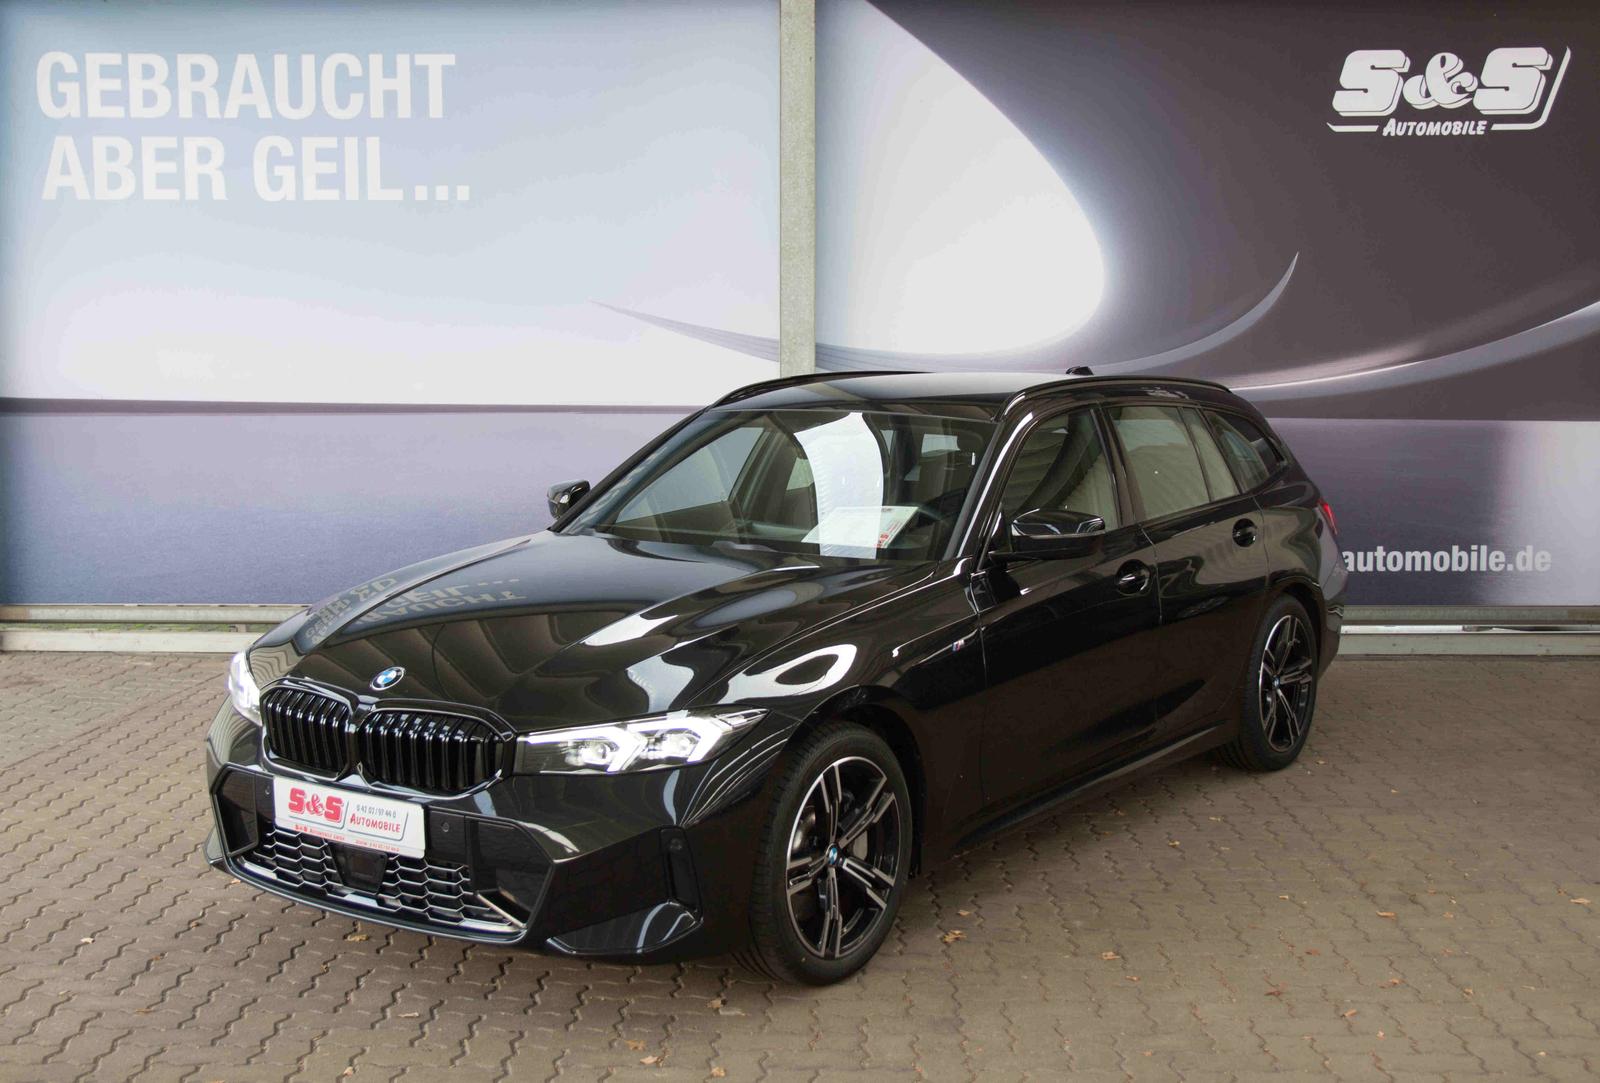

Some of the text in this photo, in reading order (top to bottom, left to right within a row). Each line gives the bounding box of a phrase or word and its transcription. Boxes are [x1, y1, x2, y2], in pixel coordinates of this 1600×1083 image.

[36, 51, 456, 119] GEBRAUCHT
[1332, 47, 1553, 116] S&S
[41, 135, 470, 201] ABER GEIL...
[288, 787, 344, 823] S&S
